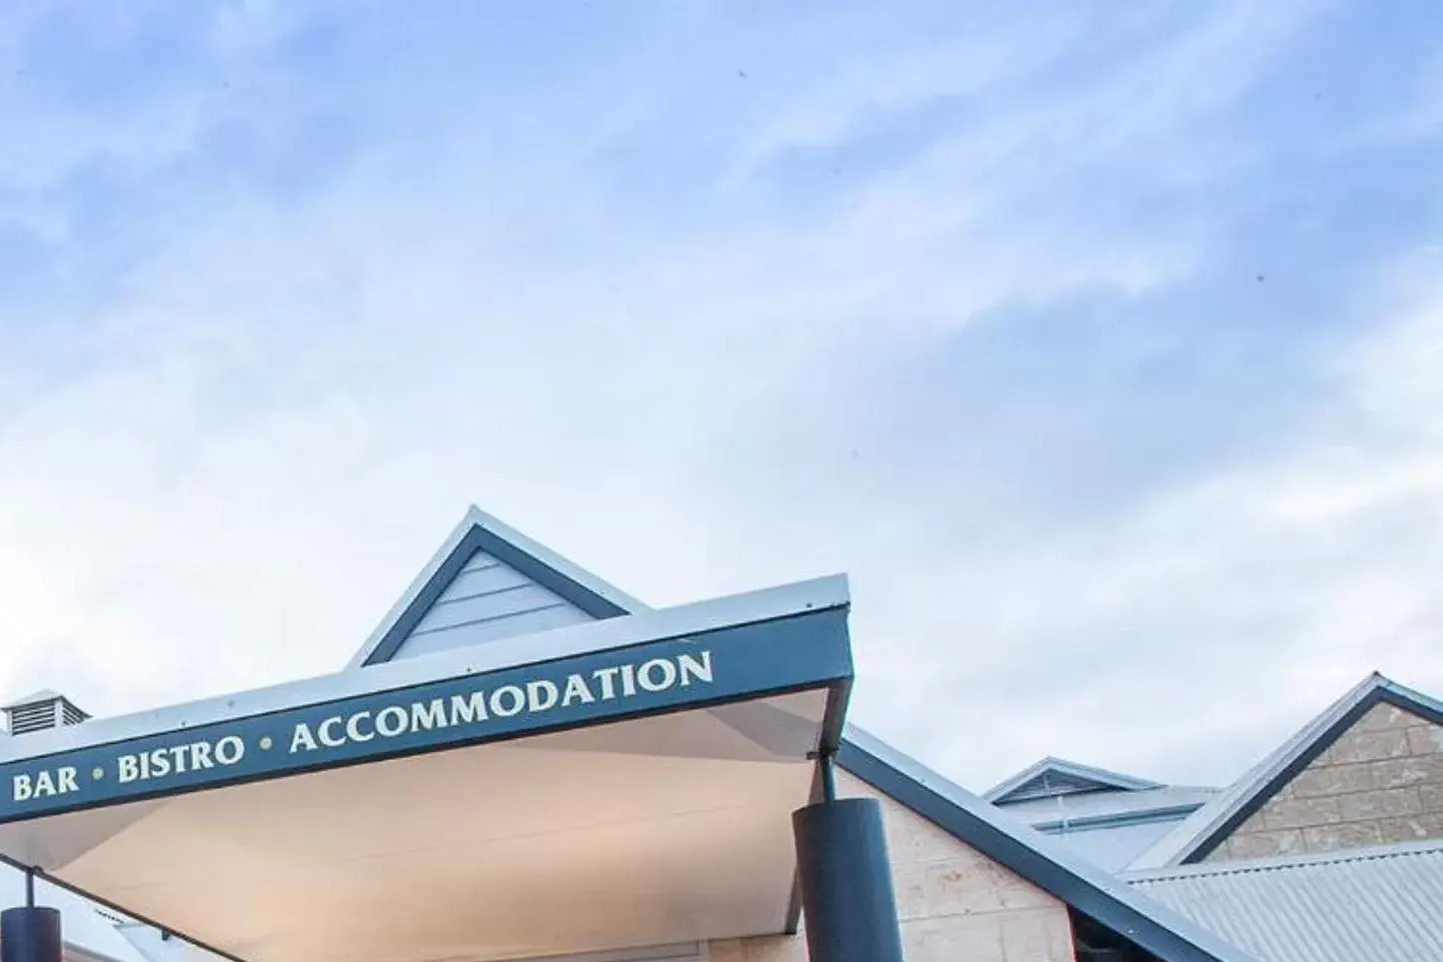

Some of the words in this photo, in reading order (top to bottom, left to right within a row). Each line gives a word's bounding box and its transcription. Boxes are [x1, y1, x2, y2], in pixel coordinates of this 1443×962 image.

[13, 767, 80, 801] BAR
[118, 735, 244, 783] BISTRO
[288, 651, 714, 753] ACCOMMODATION
